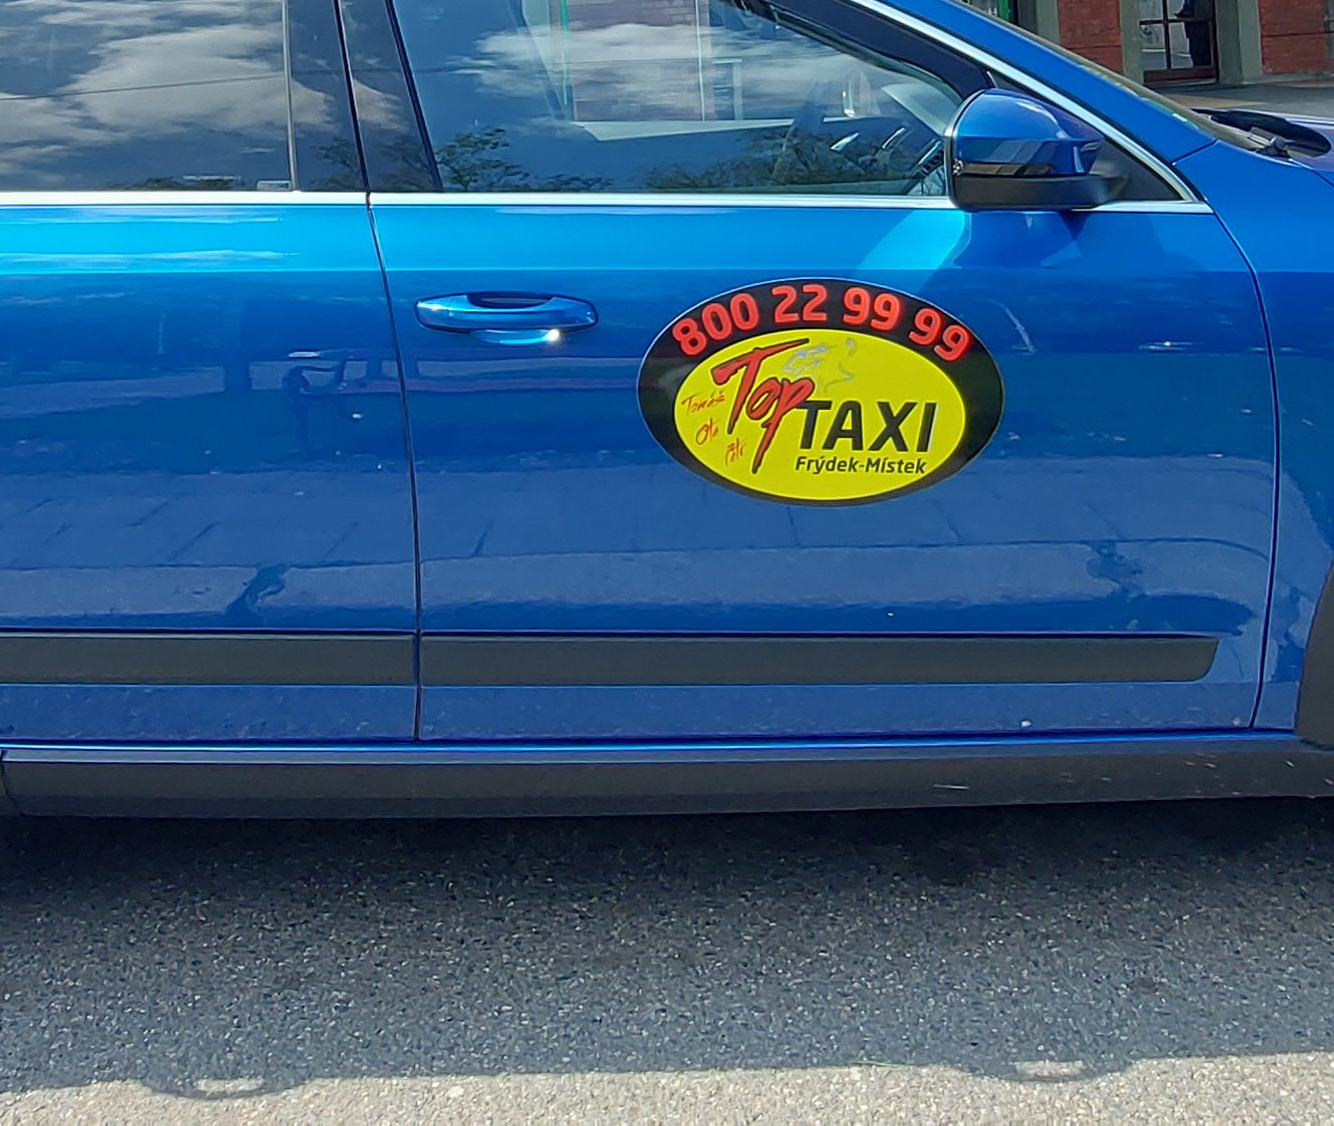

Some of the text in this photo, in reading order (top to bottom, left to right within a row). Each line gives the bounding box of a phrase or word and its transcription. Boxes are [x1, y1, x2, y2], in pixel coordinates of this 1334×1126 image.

[671, 284, 969, 362] 800 22 99 99
[711, 338, 937, 474] Top TAXI
[795, 455, 927, 475] Frýdek-Místek
